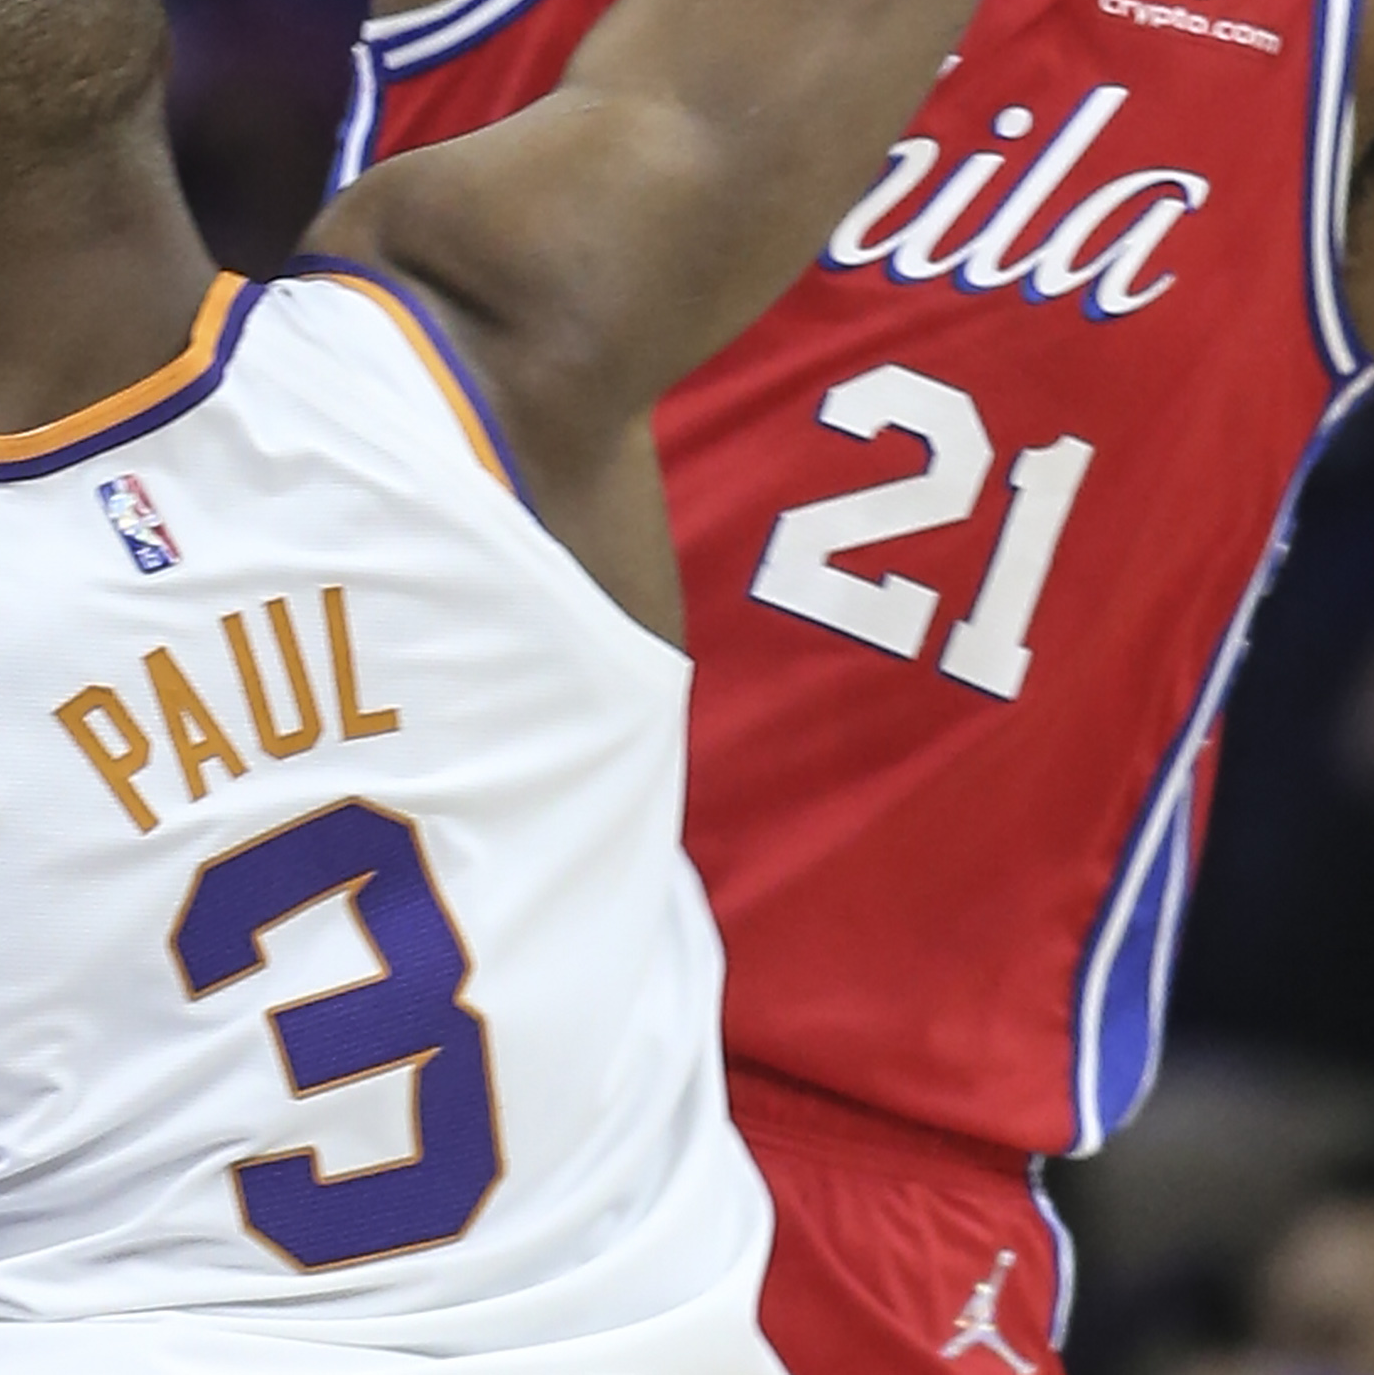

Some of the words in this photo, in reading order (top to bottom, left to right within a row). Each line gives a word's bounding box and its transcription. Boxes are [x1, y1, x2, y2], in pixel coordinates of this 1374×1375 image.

[748, 362, 1095, 702] 21
[54, 585, 402, 834] PAUL
[168, 793, 507, 1274] 3
